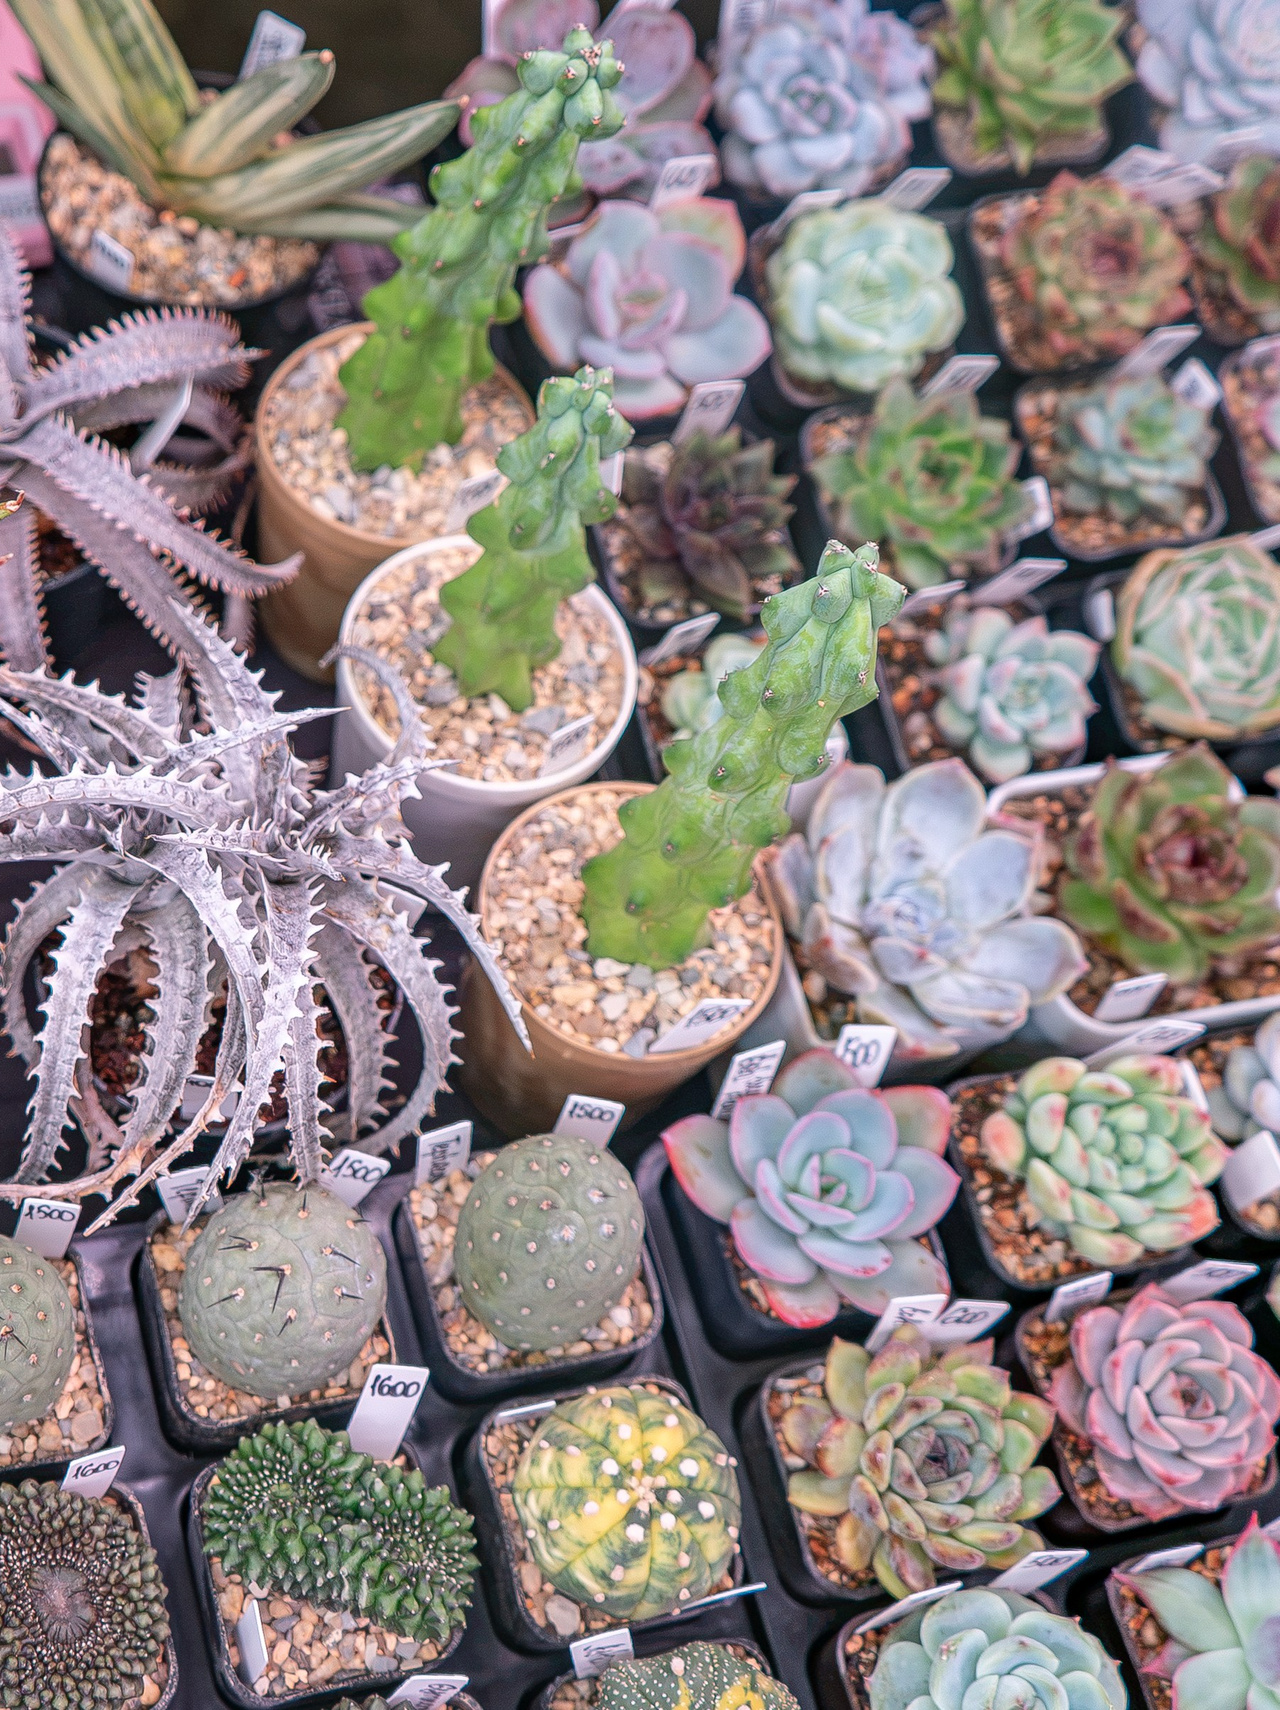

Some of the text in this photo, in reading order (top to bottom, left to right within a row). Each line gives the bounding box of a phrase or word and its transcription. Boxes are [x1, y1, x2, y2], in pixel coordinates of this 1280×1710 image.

[568, 1101, 615, 1123] 1500
[332, 1155, 383, 1183] 1500
[24, 1204, 75, 1222] 1500
[370, 1374, 421, 1398] 1600
[72, 1460, 120, 1480] 1600
